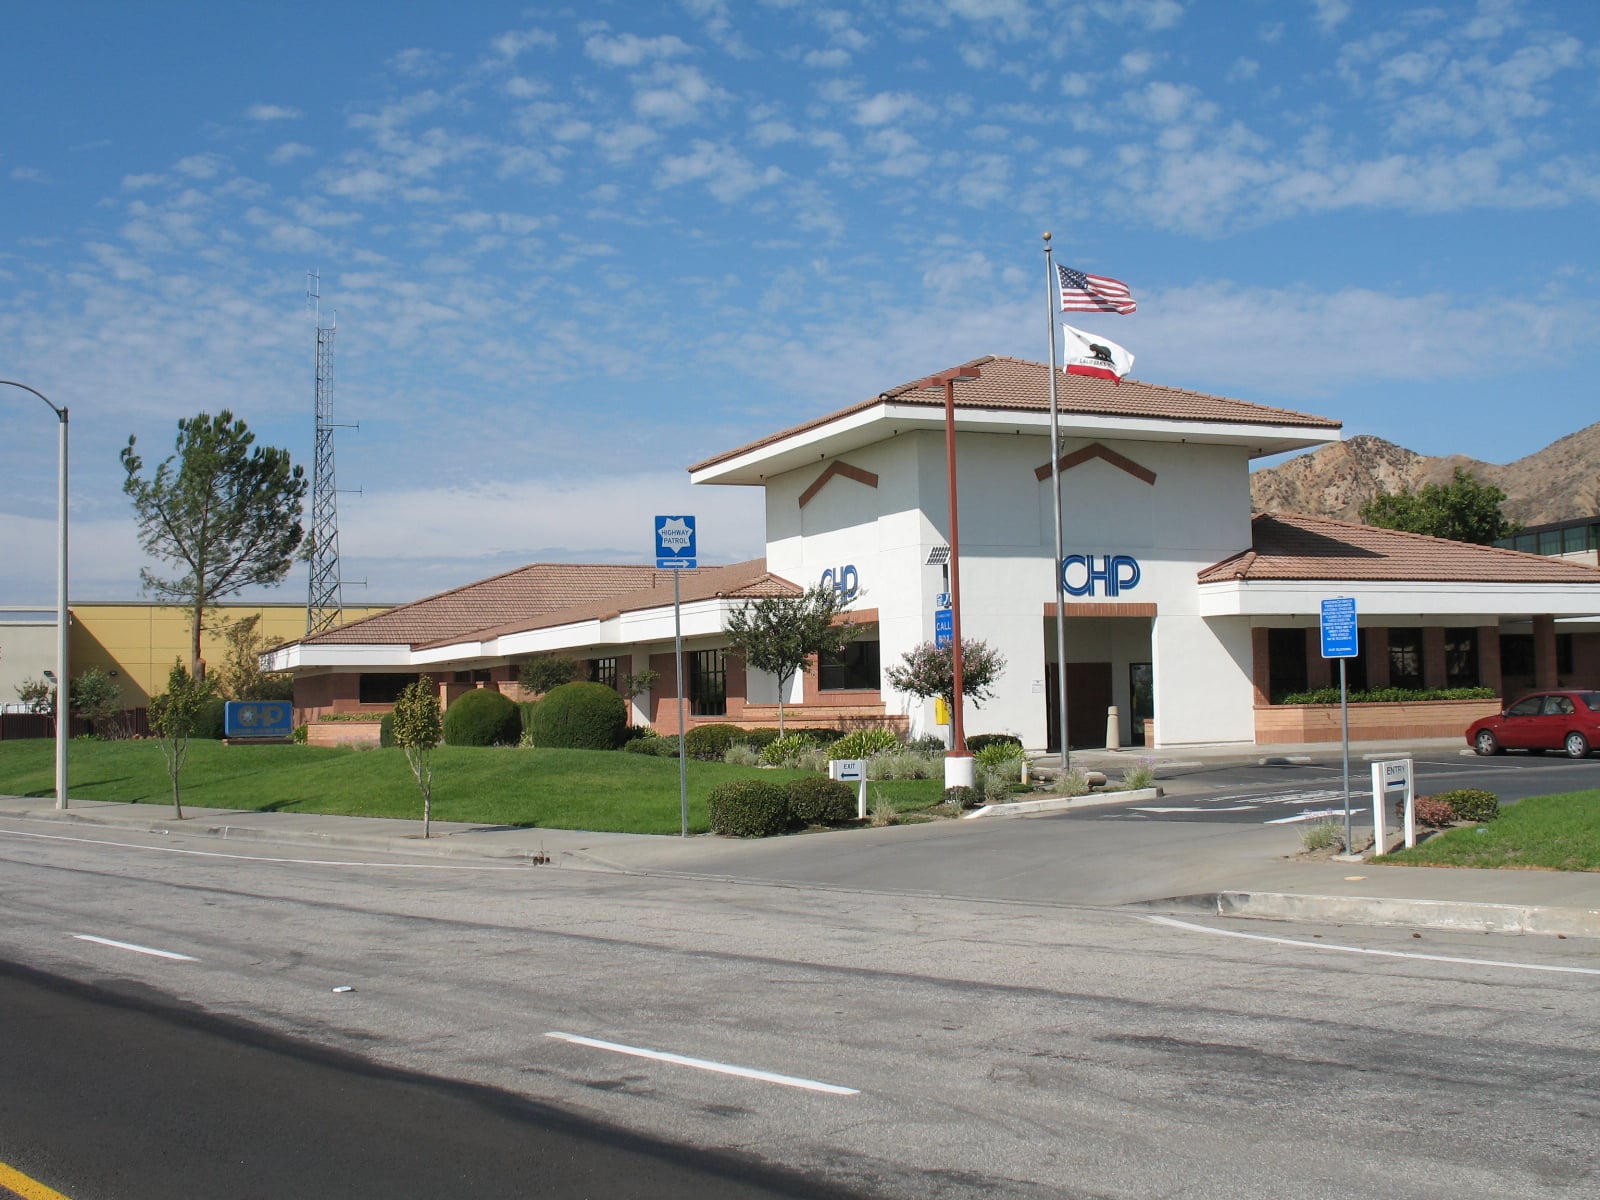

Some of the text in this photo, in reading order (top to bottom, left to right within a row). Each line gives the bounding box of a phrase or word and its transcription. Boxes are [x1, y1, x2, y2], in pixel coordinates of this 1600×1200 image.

[1062, 554, 1141, 597] CHP
[936, 621, 952, 631] CALL
[1386, 765, 1406, 775] ENTRY
